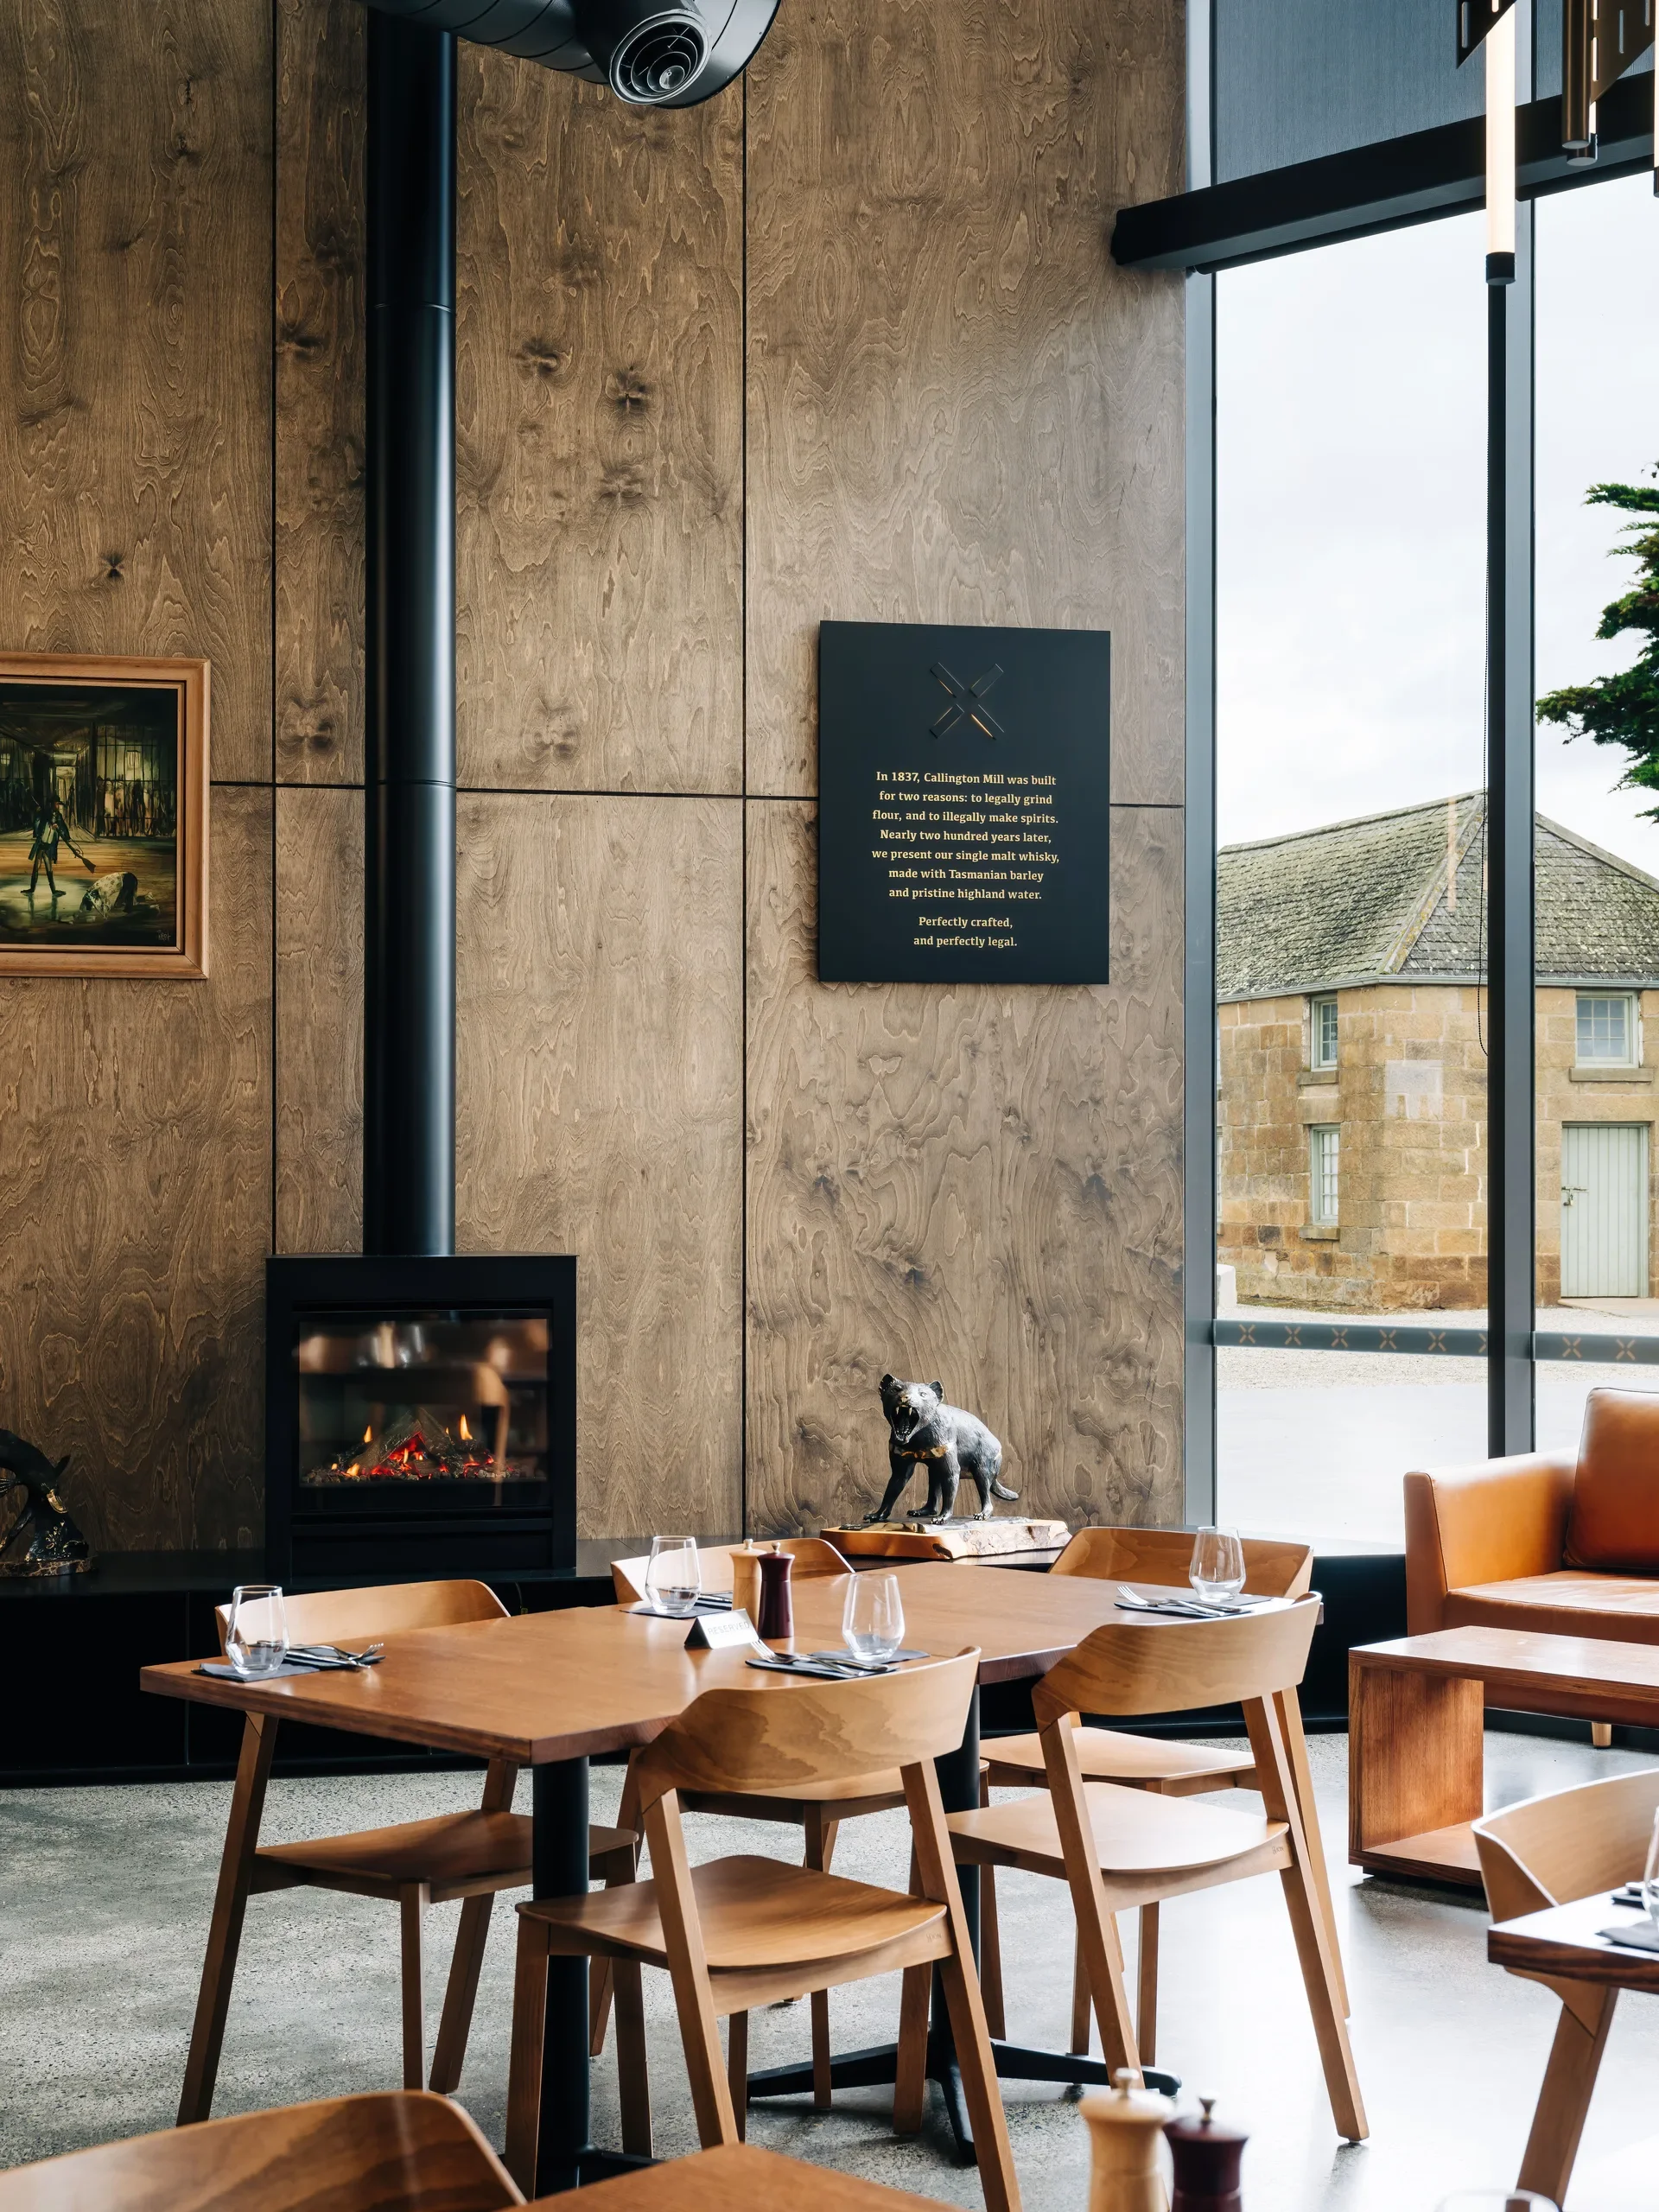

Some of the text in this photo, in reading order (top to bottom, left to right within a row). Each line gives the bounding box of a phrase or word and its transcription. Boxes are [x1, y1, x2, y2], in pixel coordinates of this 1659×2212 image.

[876, 771, 1057, 785] In 1837, Callington Mill was built
[879, 790, 1053, 807] for two reasons: to legally grind
[872, 809, 1059, 826] flour, and to illegally make spirits.
[880, 829, 1052, 844] Nearly two hundred years later,
[871, 849, 1060, 864] we present our single malt whisky,
[888, 868, 1045, 883] made with Tasmanian barley
[888, 887, 1042, 901] and pristine highland water.
[918, 916, 1014, 930] Perfectly crafted,
[913, 935, 1018, 949] and perfectly legal.
[707, 1621, 750, 1635] RESERVED
